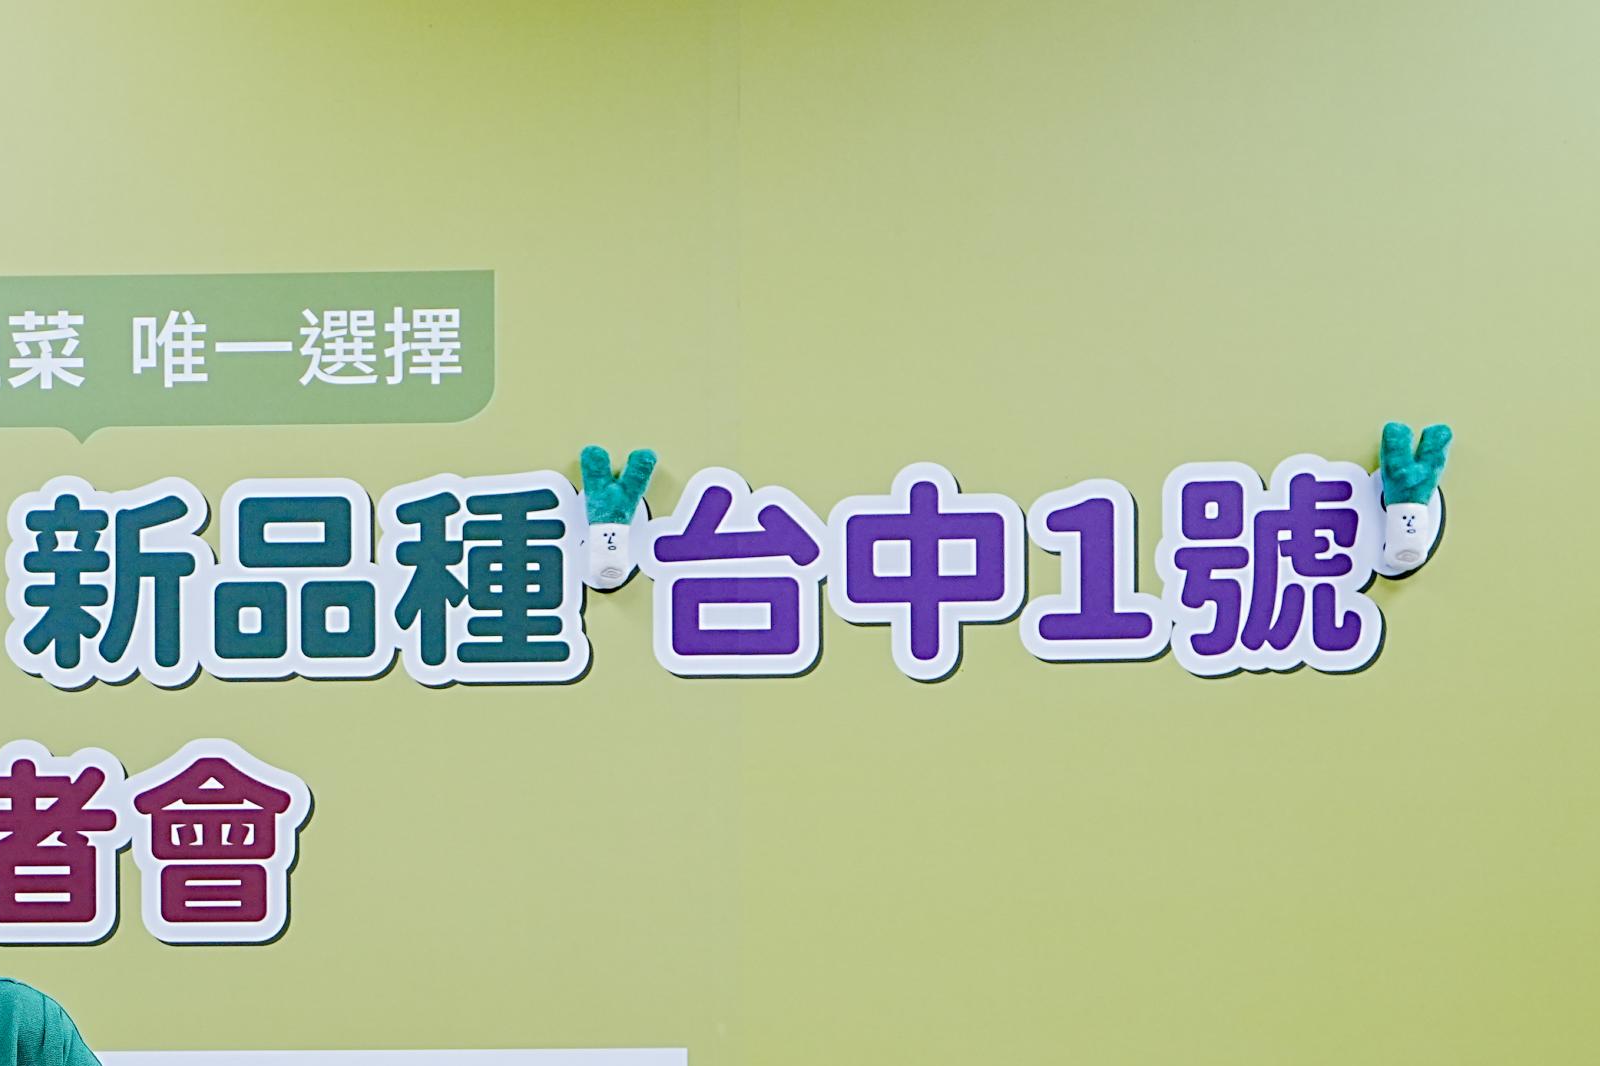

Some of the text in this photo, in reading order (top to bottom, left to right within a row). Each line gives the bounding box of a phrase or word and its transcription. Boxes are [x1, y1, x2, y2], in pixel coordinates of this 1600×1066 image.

[131, 306, 463, 388] 唯一選擇
[22, 488, 549, 670] 新品種
[652, 472, 1362, 662] 台中1號
